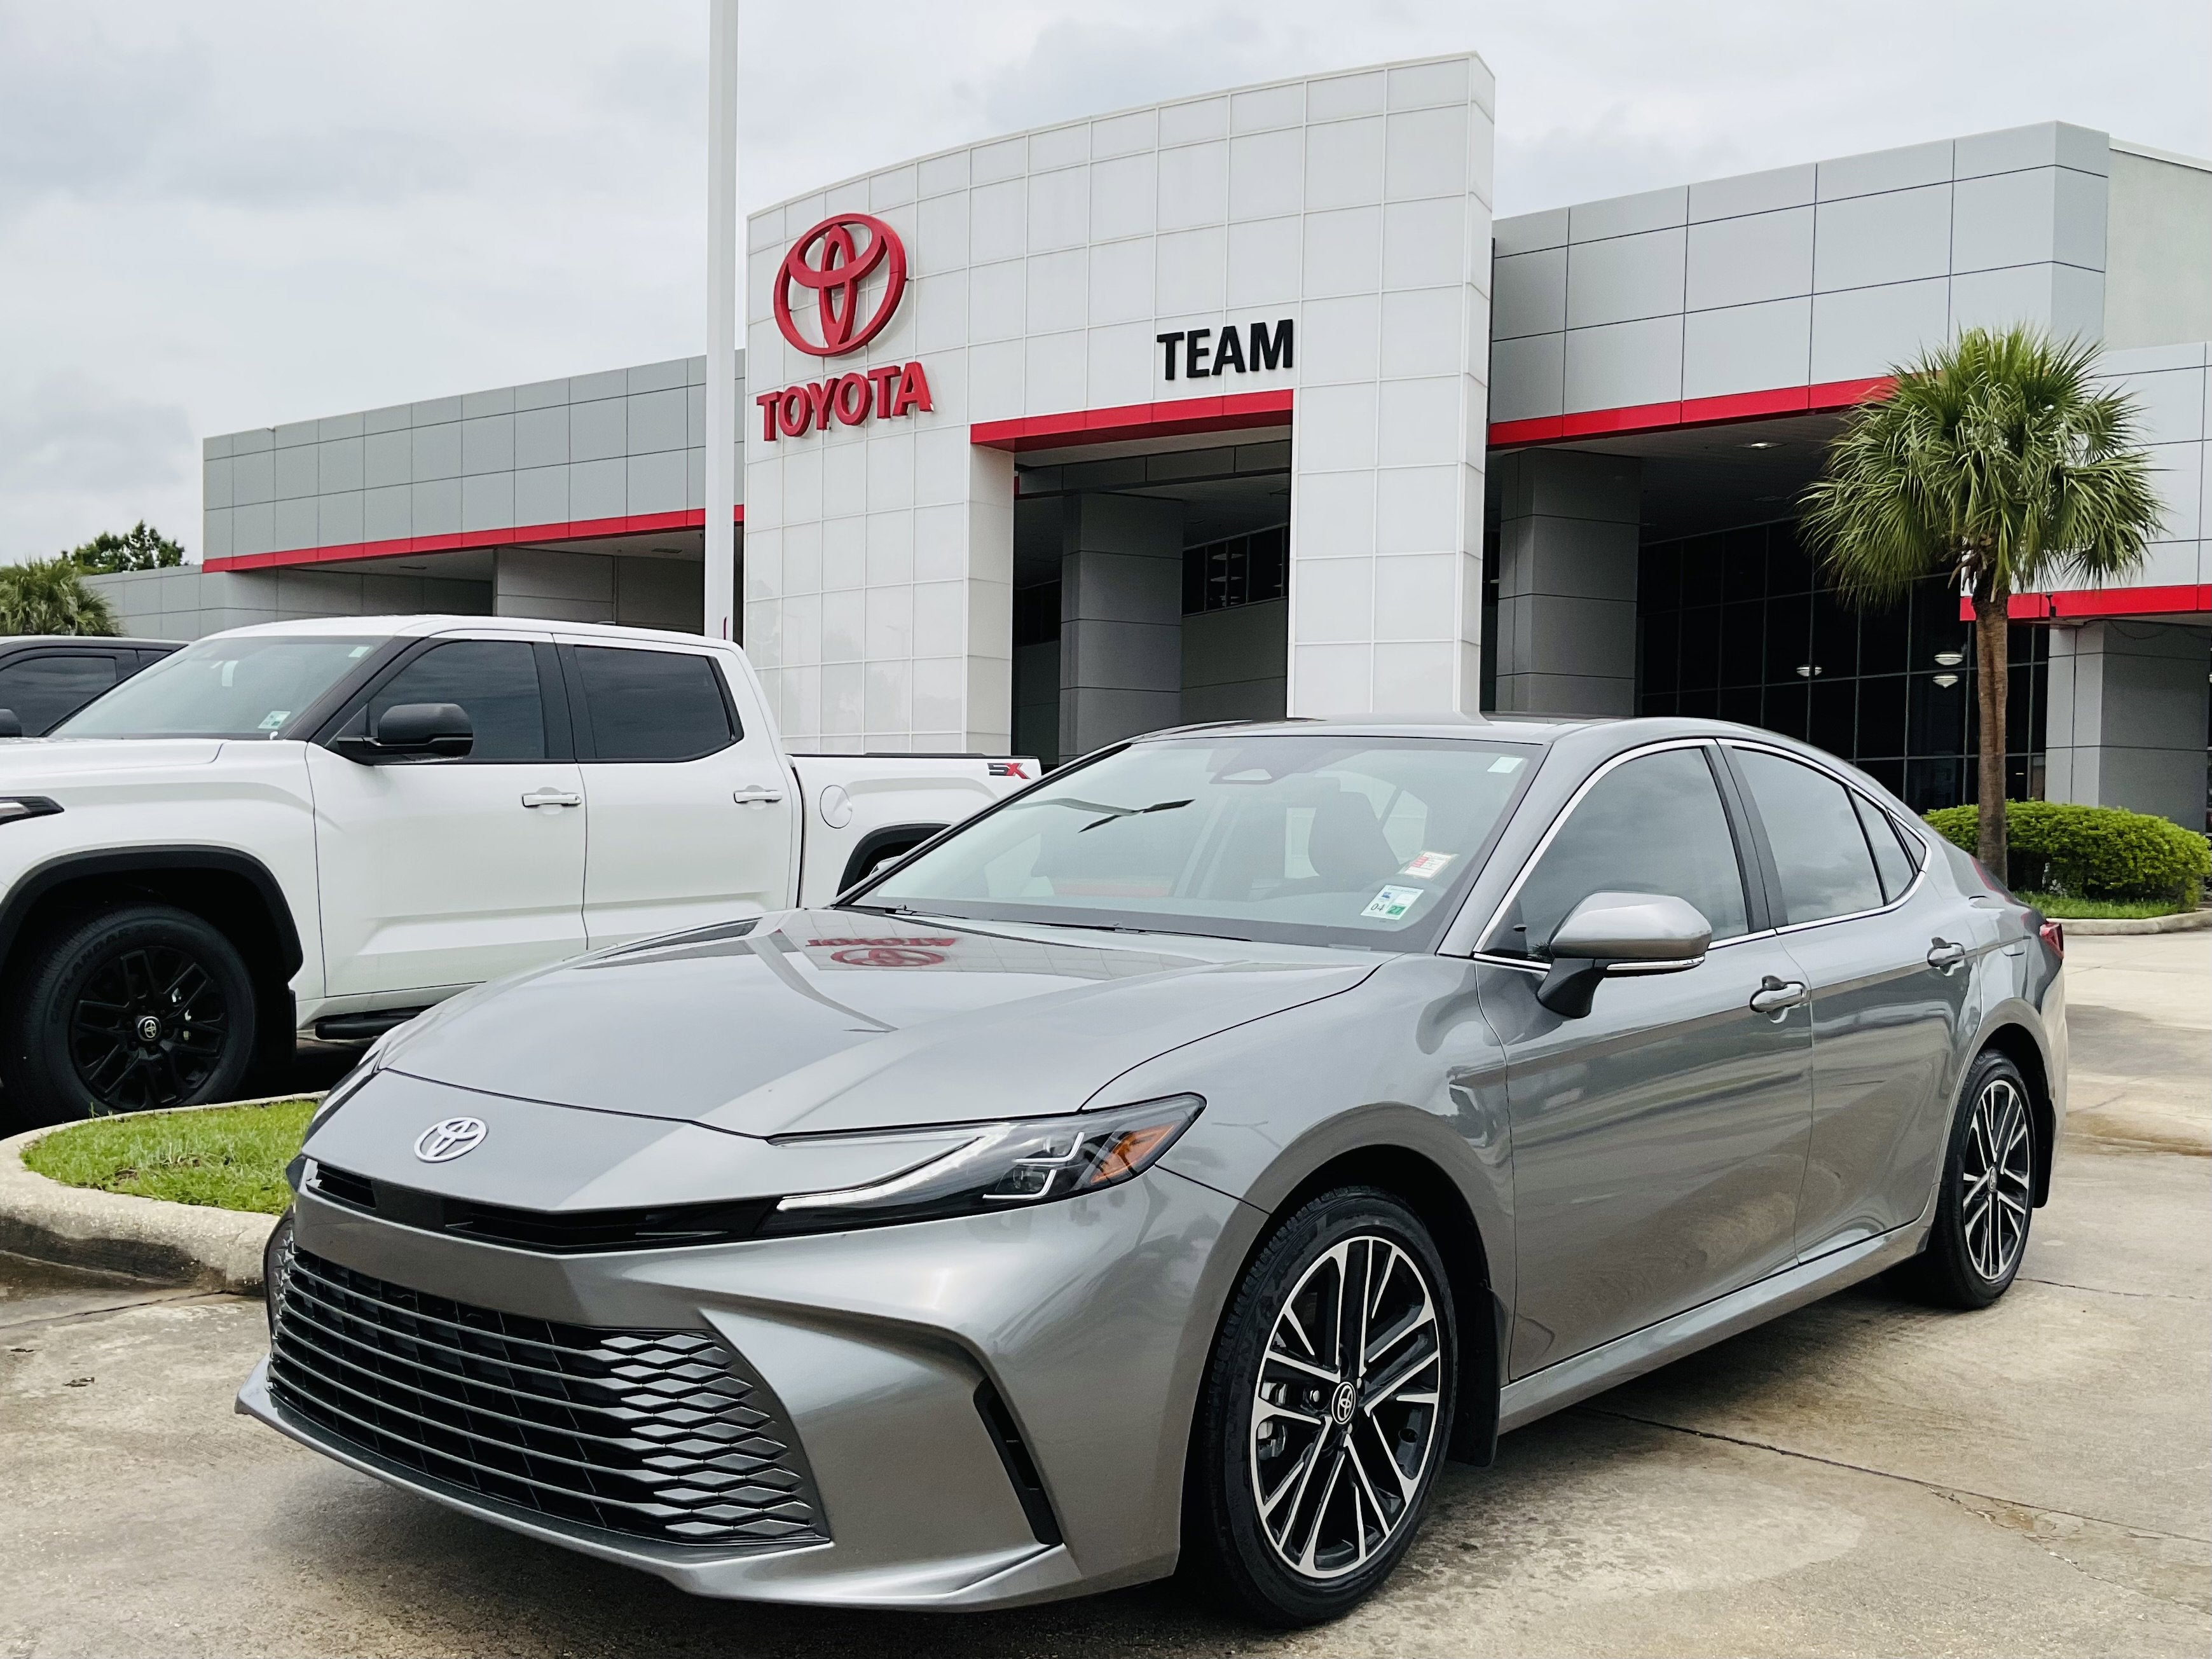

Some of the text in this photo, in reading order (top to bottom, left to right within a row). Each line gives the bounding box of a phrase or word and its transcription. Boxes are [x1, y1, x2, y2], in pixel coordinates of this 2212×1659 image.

[1157, 319, 1293, 380] TEAM
[757, 361, 933, 441] TOYOTA
[1370, 903, 1405, 915] 04 27
